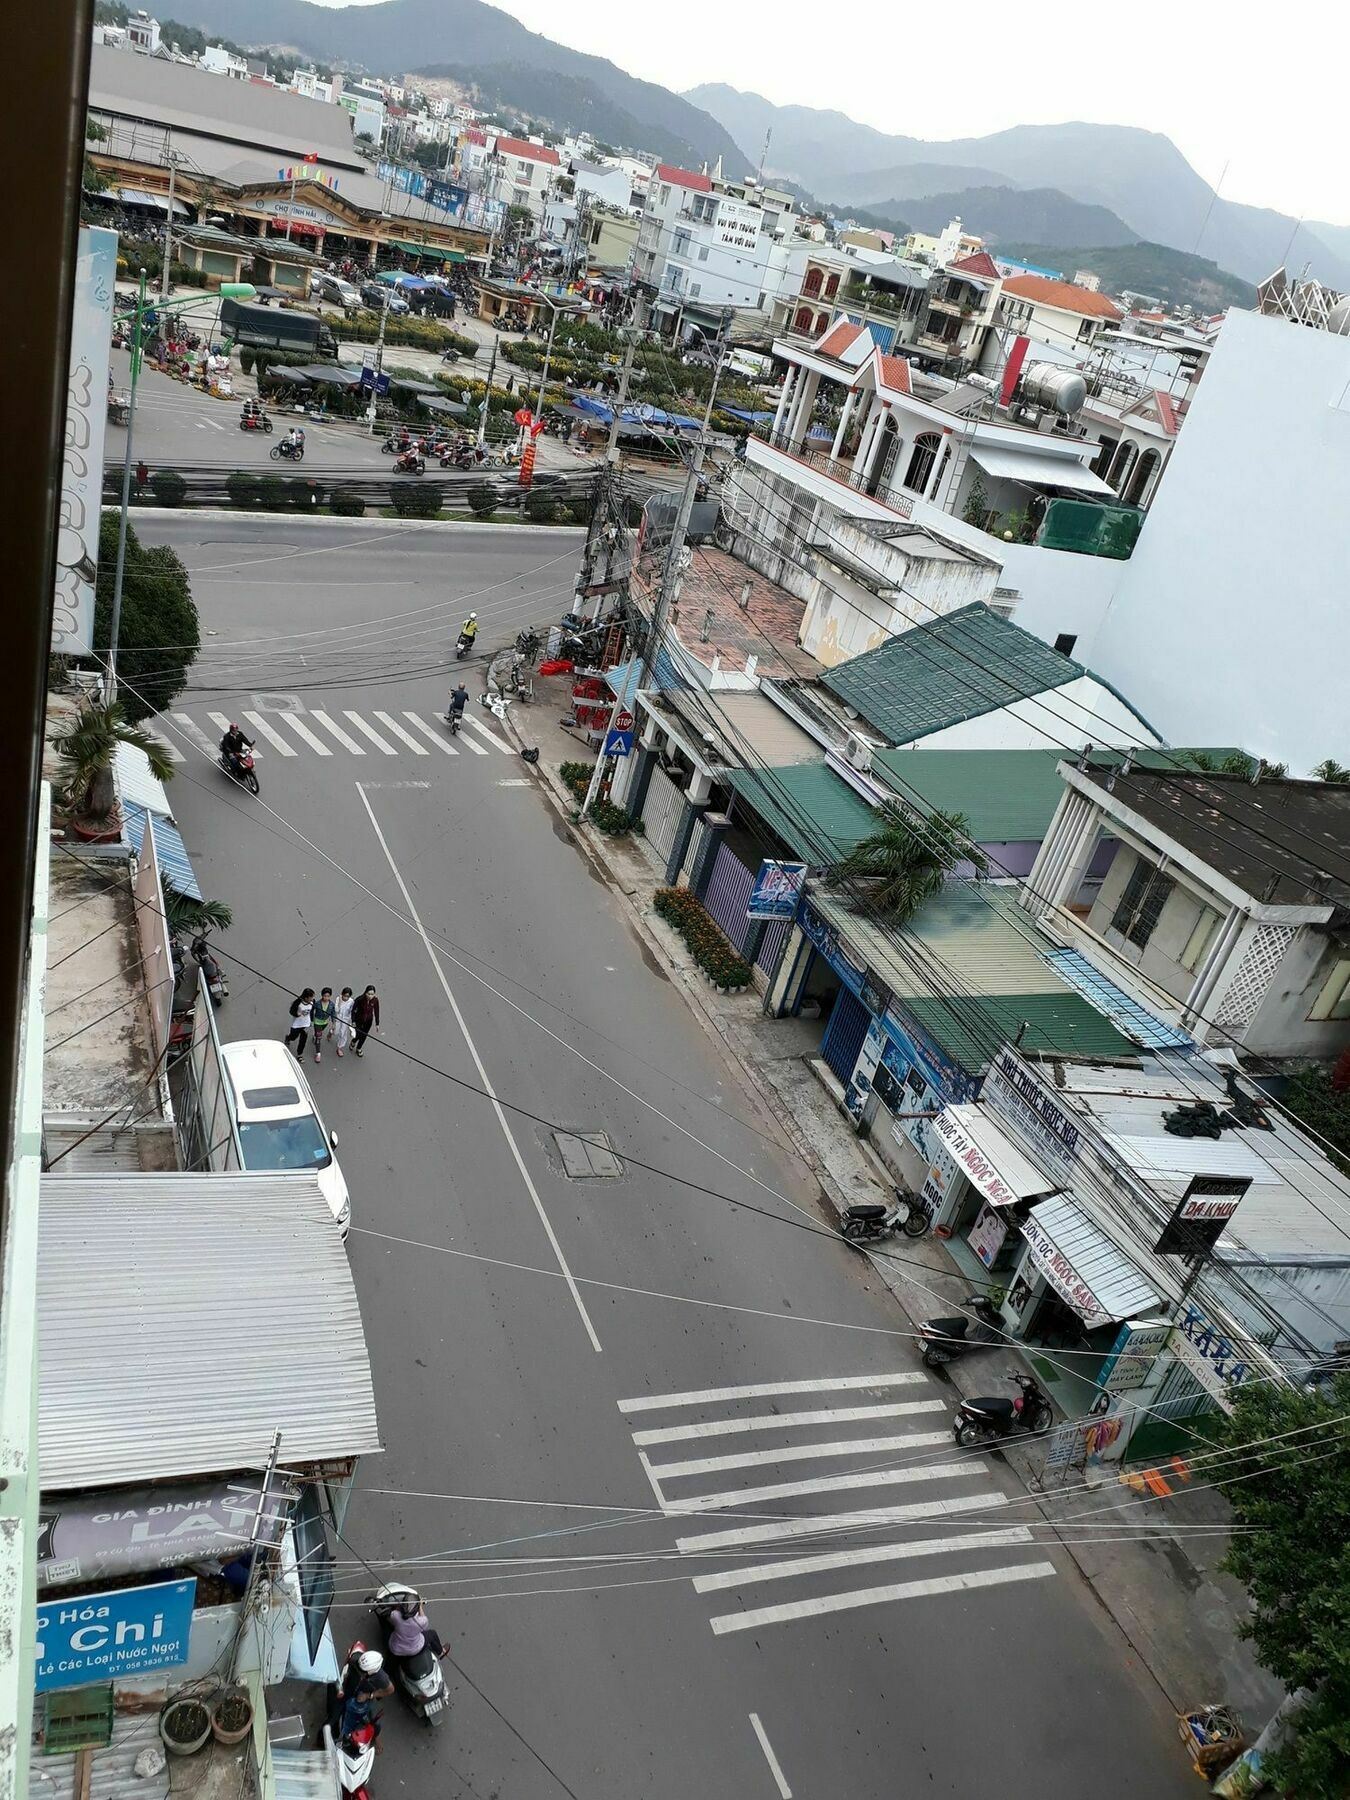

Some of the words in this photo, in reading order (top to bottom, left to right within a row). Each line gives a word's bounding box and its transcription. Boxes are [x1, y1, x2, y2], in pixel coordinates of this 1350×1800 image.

[616, 718, 633, 726] STOP
[1060, 1119, 1079, 1150] NGA
[935, 1112, 959, 1139] THUỐC
[984, 1178, 1013, 1204] NGA
[1021, 1220, 1041, 1242] UỐN
[1036, 1238, 1054, 1259] TÓC
[1072, 1284, 1101, 1317] SANG
[1195, 1366, 1212, 1387] CHI
[91, 1508, 139, 1523] GIA
[221, 1494, 253, 1508] G7
[59, 1605, 110, 1625] Hóa
[69, 1613, 164, 1652] Chi
[39, 1662, 54, 1675] Lẻ
[58, 1659, 83, 1672] Các
[86, 1651, 113, 1667] Loại
[116, 1647, 148, 1661] Nước
[151, 1640, 180, 1655] Ngọt
